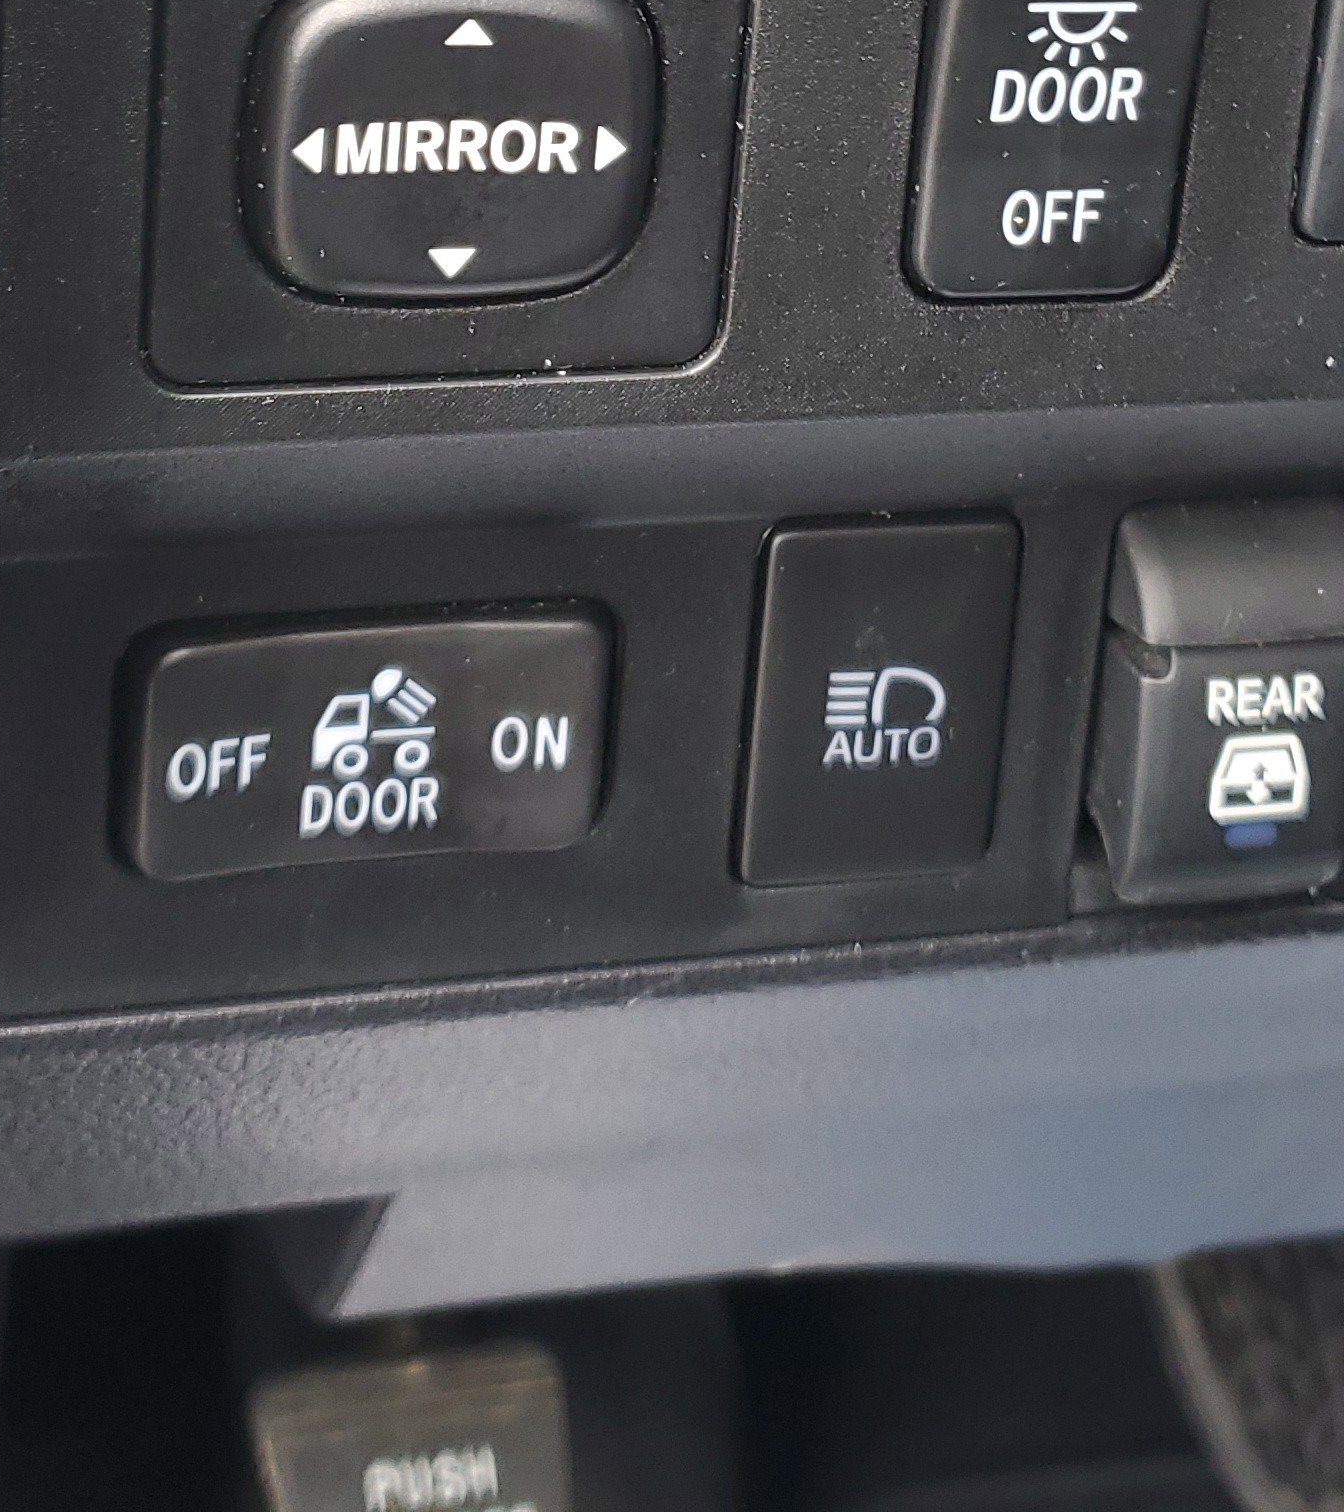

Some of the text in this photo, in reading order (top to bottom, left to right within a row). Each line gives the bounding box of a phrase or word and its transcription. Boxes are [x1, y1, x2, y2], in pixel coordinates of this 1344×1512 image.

[990, 67, 1143, 123] DOOR
[335, 120, 580, 175] MIRROR
[1002, 189, 1105, 246] OFF
[1207, 673, 1325, 727] REAR
[165, 734, 271, 802] OFF
[491, 716, 569, 771] ON
[823, 727, 941, 769] AUTO
[299, 777, 440, 839] DOOR
[363, 1443, 500, 1511] PUSH
